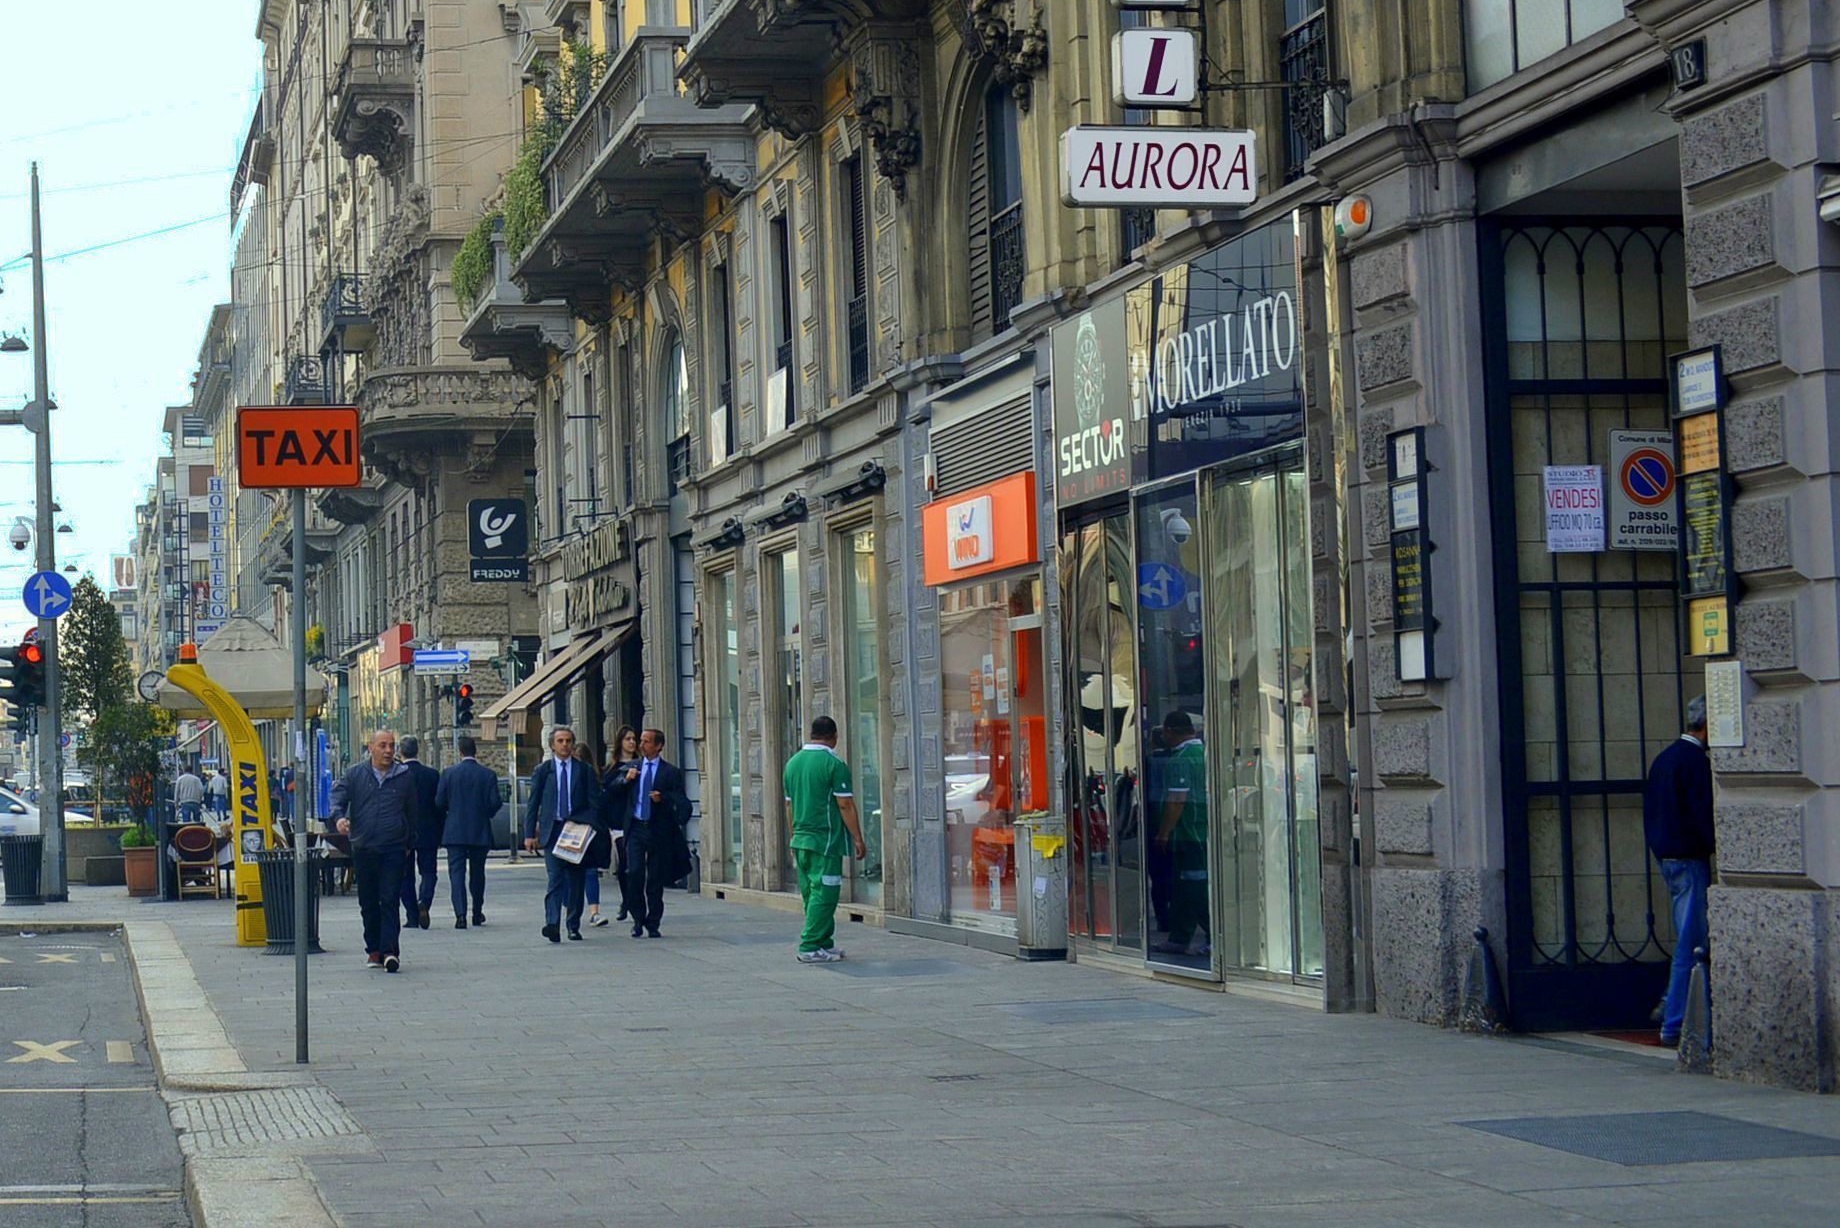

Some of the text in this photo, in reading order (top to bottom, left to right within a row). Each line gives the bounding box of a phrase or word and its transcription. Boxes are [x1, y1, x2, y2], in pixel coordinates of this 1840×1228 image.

[1079, 141, 1249, 190] AURORA
[1141, 291, 1295, 419] MORELLATO
[245, 429, 353, 465] TAXI
[1061, 418, 1125, 477] SECTOR
[1063, 468, 1126, 500] NO LIMITS
[1547, 488, 1600, 508] VENDESI
[1620, 524, 1677, 535] carrabile
[1629, 512, 1668, 522] passo
[209, 478, 224, 617] HOTEL TECO
[473, 569, 520, 579] FREDDY
[239, 761, 259, 826] TAXI
